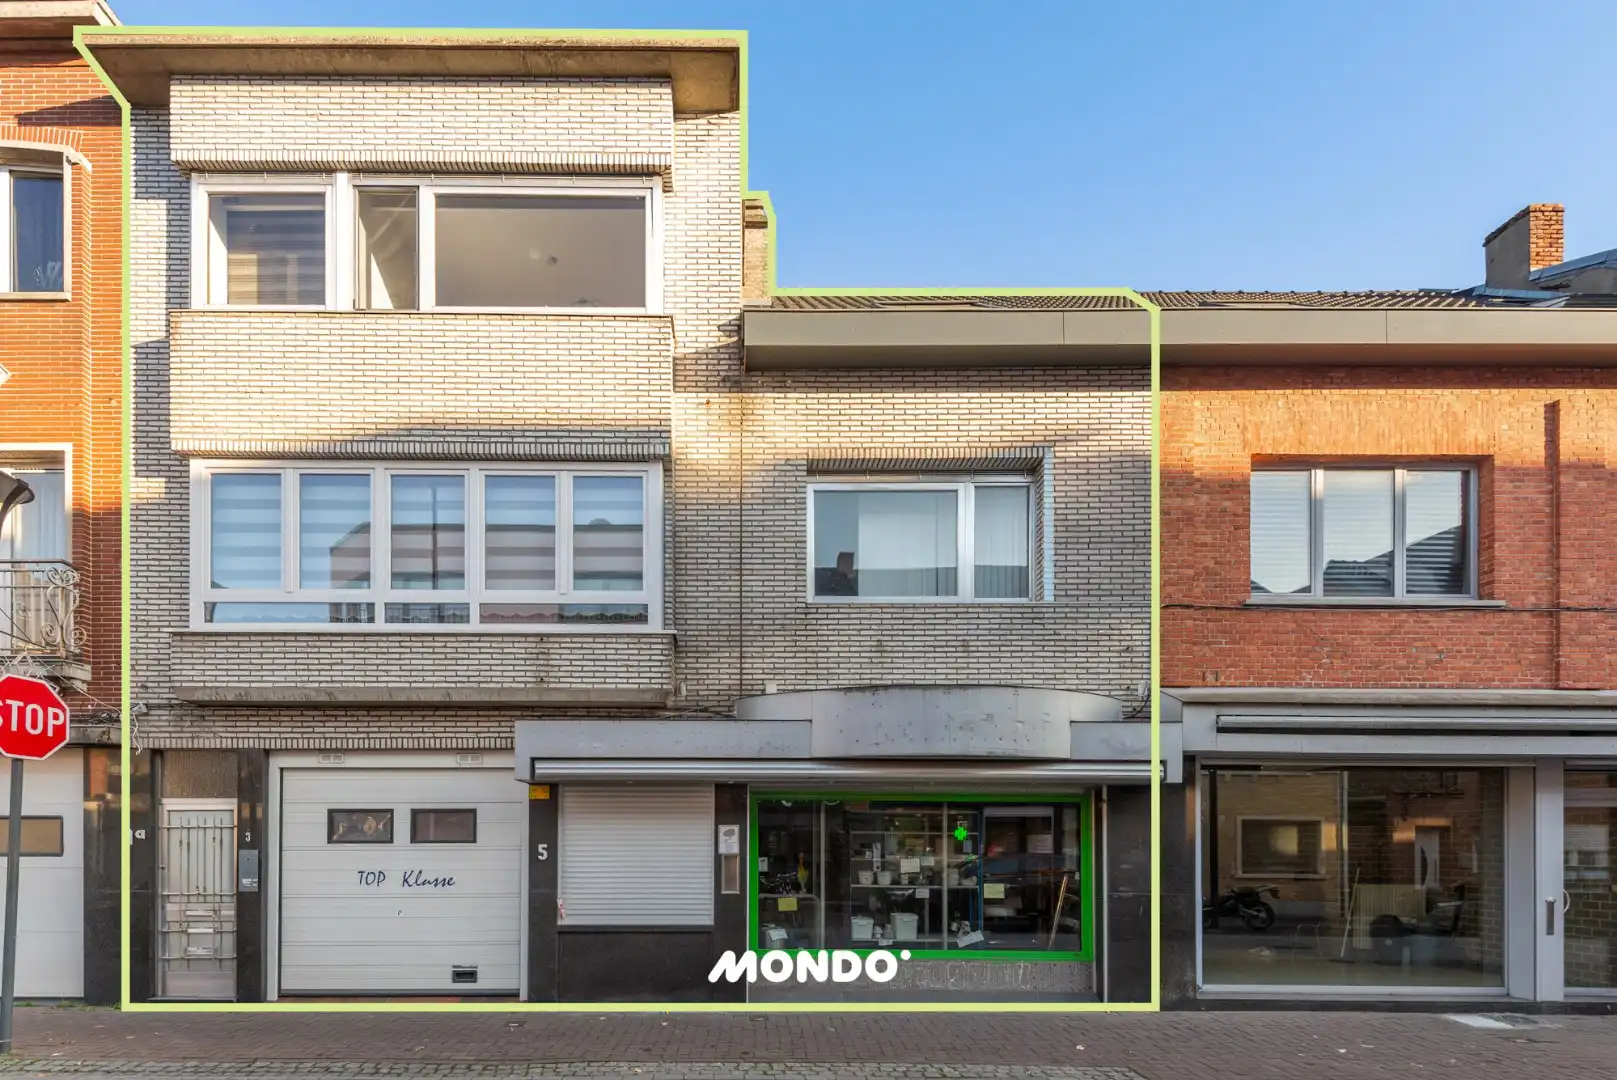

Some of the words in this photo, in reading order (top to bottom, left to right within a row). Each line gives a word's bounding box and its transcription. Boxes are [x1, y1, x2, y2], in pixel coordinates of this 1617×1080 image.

[0, 698, 65, 737] TOP
[245, 831, 251, 842] 3
[537, 843, 548, 861] 5
[357, 870, 386, 887] TOP
[402, 869, 455, 888] Klasse
